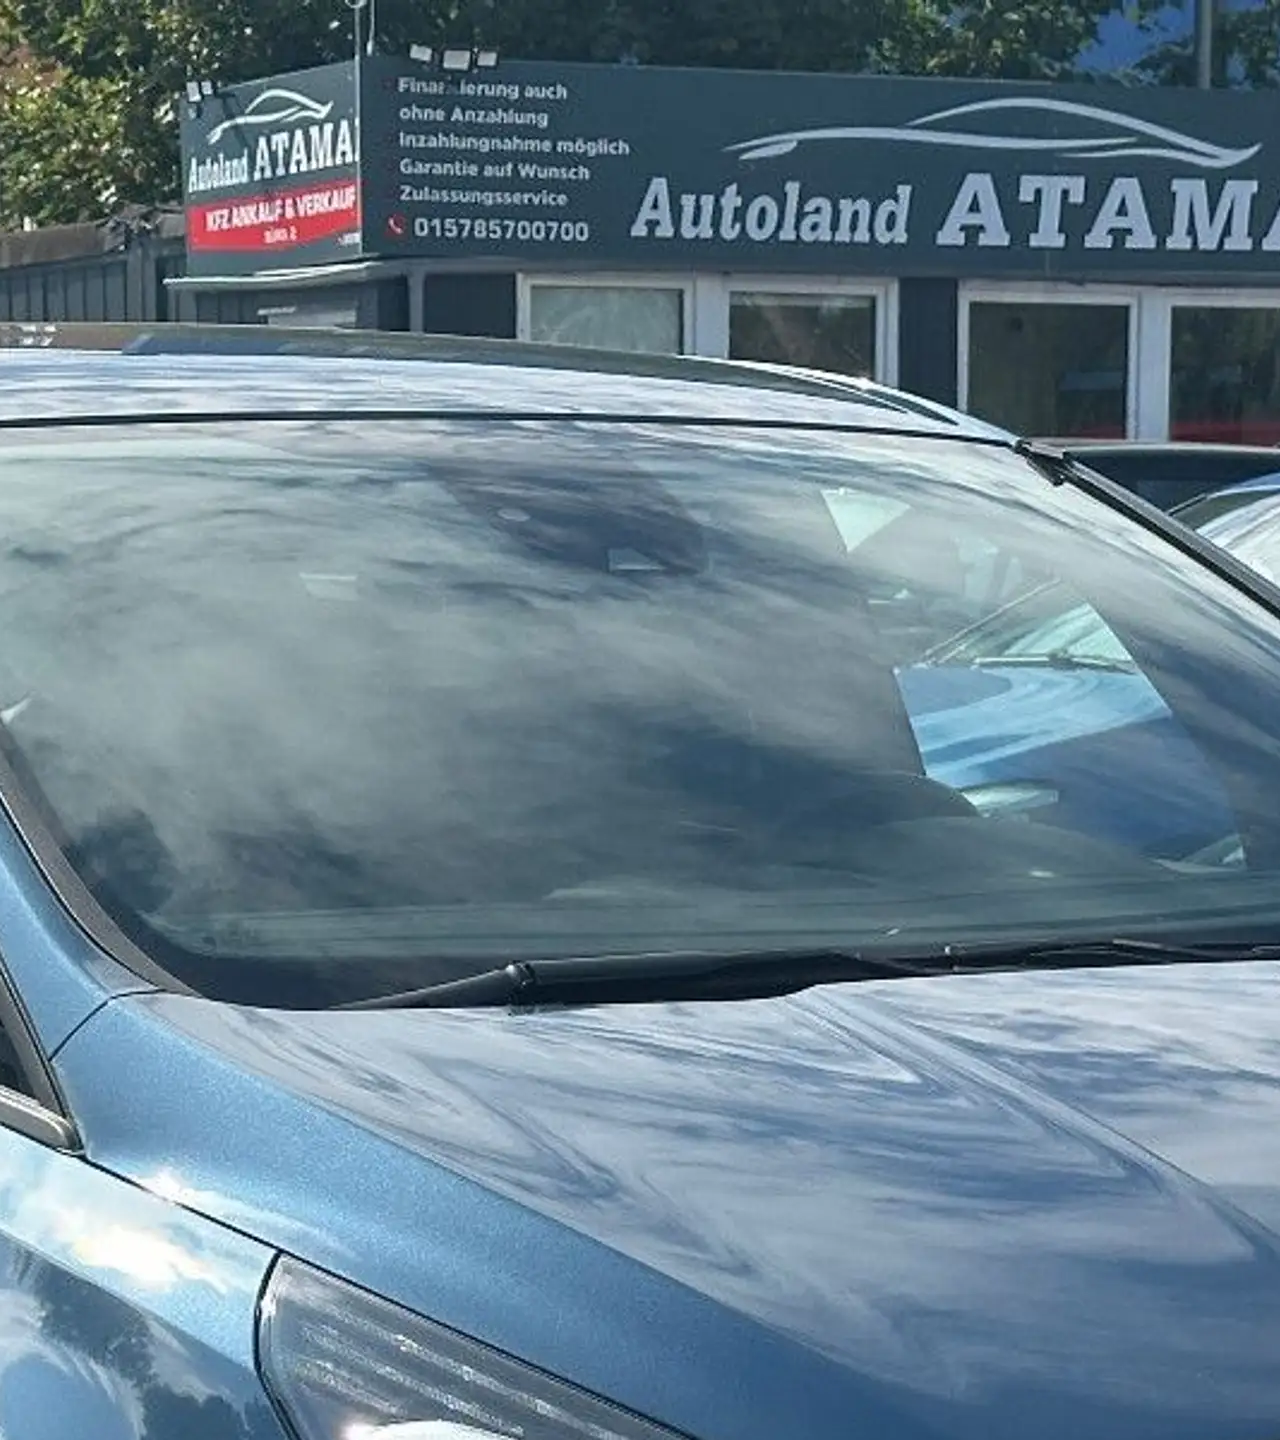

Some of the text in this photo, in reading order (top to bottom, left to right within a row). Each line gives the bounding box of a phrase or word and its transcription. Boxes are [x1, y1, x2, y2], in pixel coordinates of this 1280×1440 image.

[524, 83, 568, 99] auch
[399, 104, 549, 128] ohne Anzahlung
[399, 132, 630, 157] Inzahlungnahme möglich
[188, 148, 250, 193] Autoland
[400, 158, 591, 181] Garantie auf Wunsch
[400, 185, 569, 206] Zulassungsservice
[205, 207, 231, 232] KFZ
[232, 199, 283, 229] ANKAUF
[296, 185, 357, 218] VERKAUF
[630, 176, 913, 245] Autoland
[414, 217, 589, 242] 015785700700
